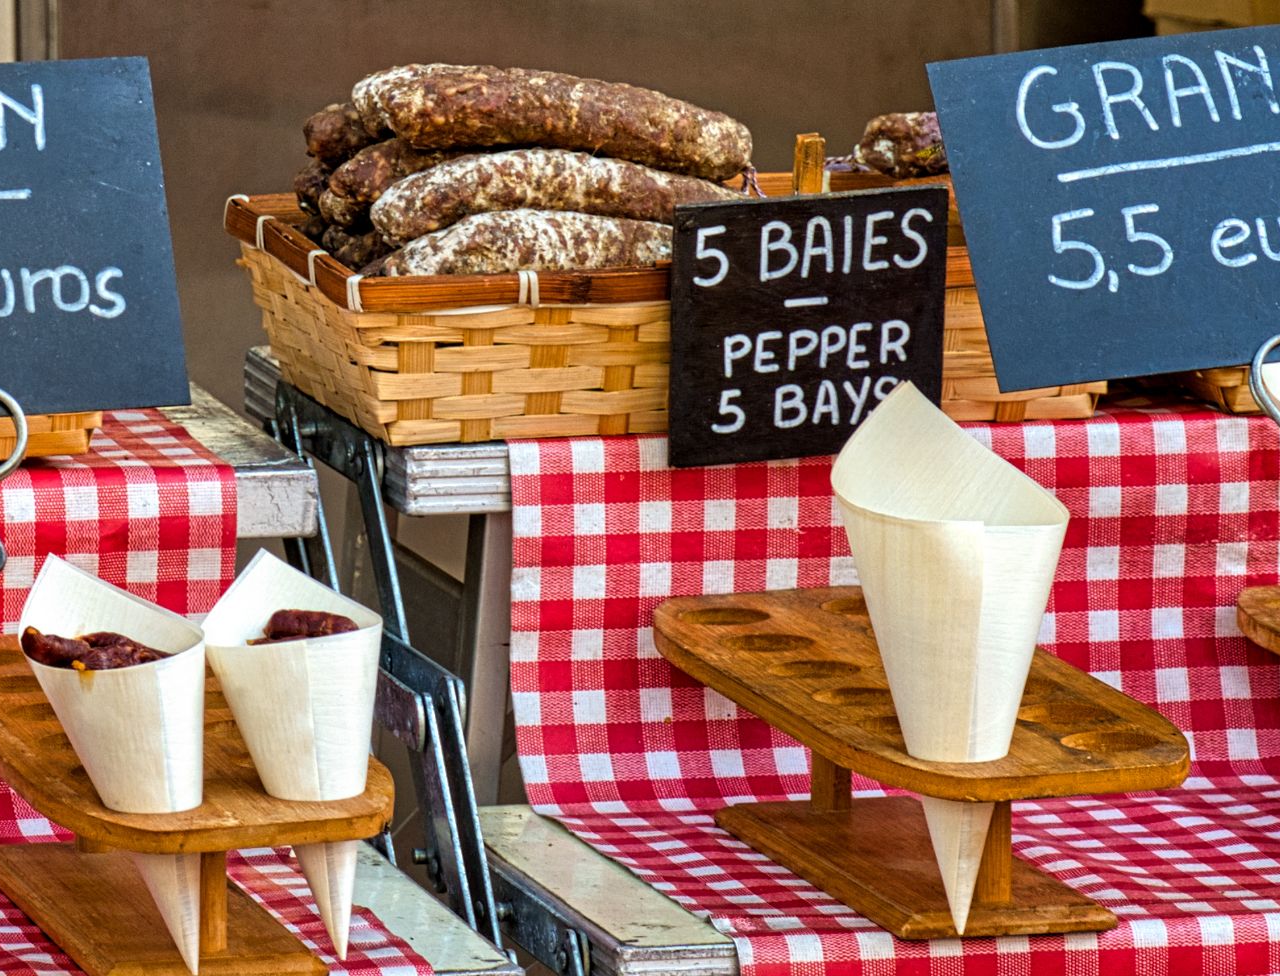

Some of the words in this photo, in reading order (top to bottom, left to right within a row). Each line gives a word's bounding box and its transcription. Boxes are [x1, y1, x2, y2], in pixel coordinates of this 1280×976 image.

[692, 224, 730, 288] 5
[759, 207, 934, 283] BAIES
[1047, 203, 1174, 293] 5,5
[723, 319, 911, 379] PEPPER
[711, 388, 747, 434] 5
